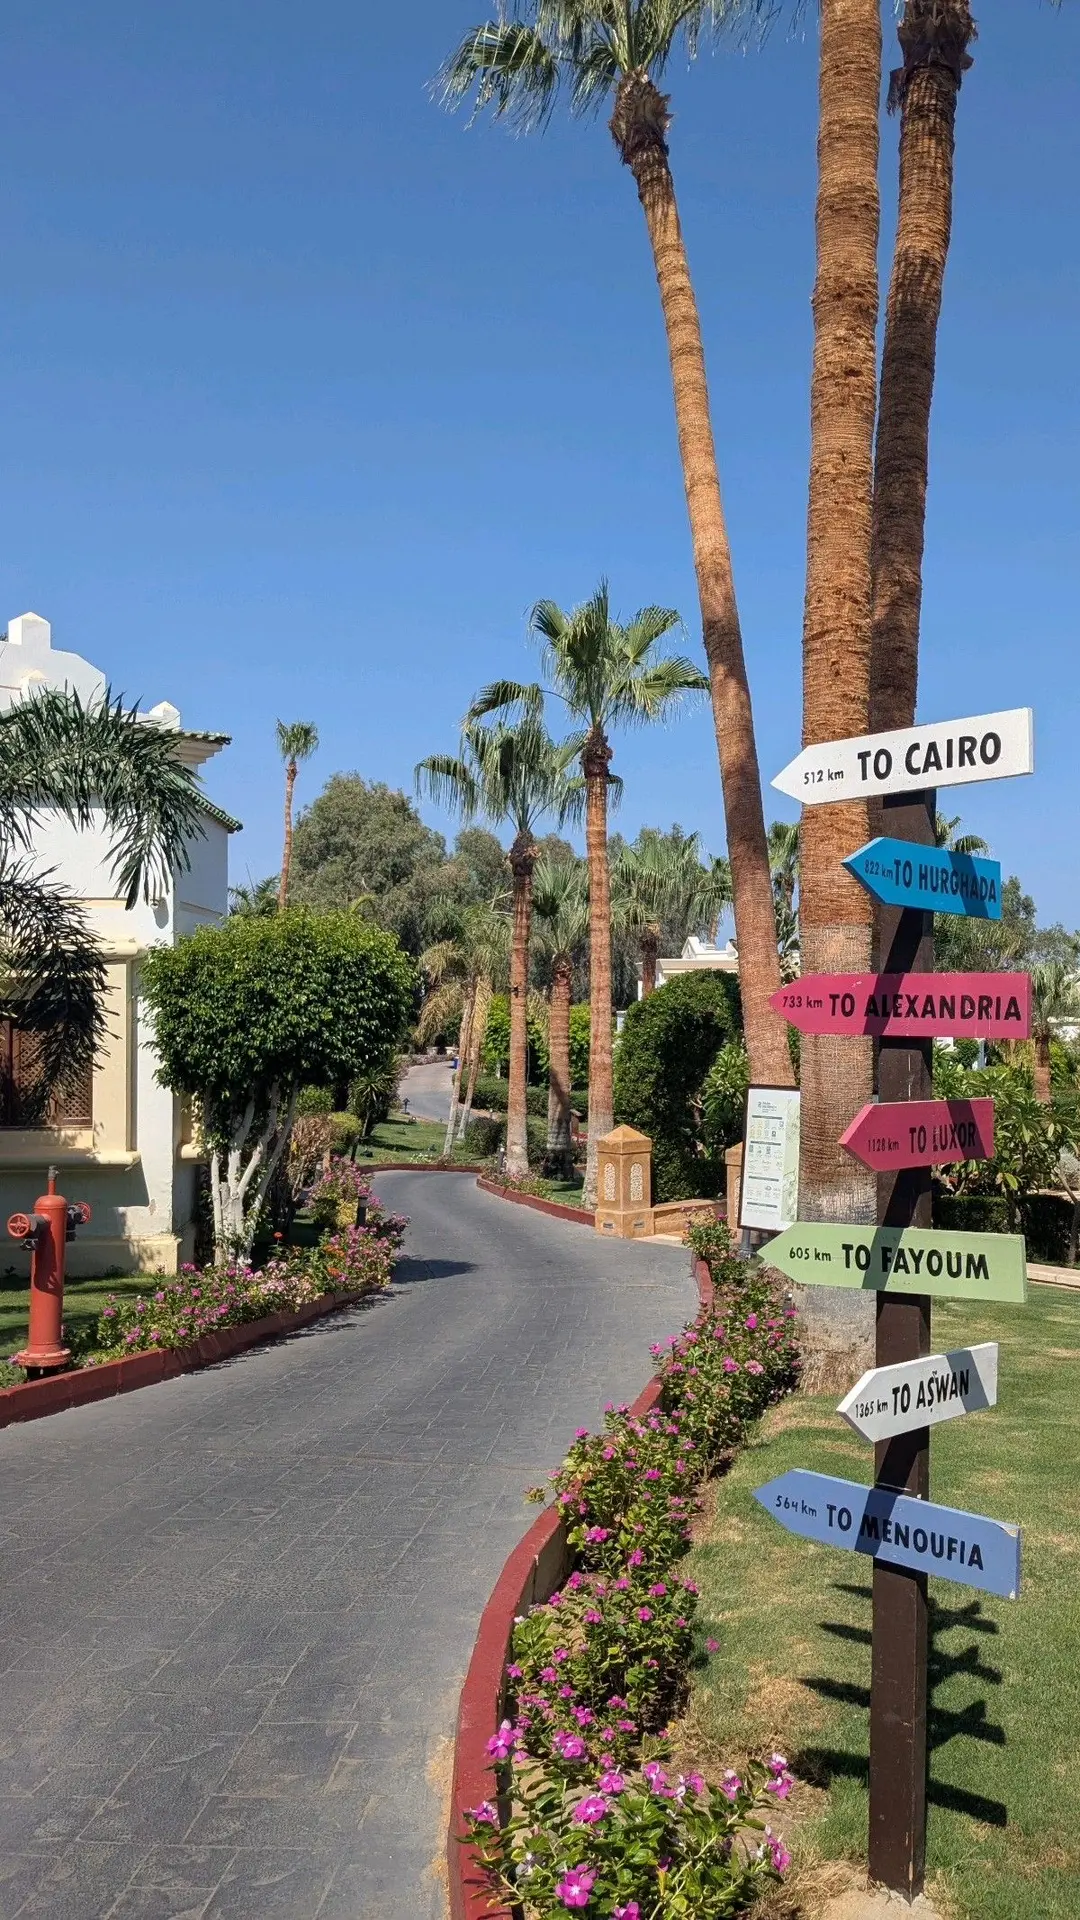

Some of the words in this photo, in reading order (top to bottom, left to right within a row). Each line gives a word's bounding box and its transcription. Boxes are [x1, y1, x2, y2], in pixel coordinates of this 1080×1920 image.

[803, 770, 824, 785] 512
[827, 769, 845, 781] km
[857, 748, 893, 781] TO
[904, 731, 1002, 775] CAIRO
[864, 859, 880, 875] 822
[881, 865, 894, 880] km
[894, 858, 913, 889] TO
[918, 863, 997, 903] HURGHADA
[782, 995, 803, 1009] 733
[806, 995, 823, 1009] km
[828, 993, 856, 1017] TO
[864, 994, 1022, 1021] ALEXANDRIA
[867, 1137, 886, 1152] 1128
[888, 1138, 900, 1151] km
[909, 1125, 927, 1154] TO
[932, 1121, 976, 1152] LUXOR
[789, 1247, 811, 1261] 605
[814, 1248, 832, 1262] km
[841, 1243, 871, 1271] TO
[880, 1246, 990, 1280] FAYOUM
[855, 1400, 874, 1418] 1365
[876, 1399, 889, 1412] km
[891, 1382, 911, 1416] TO
[916, 1369, 970, 1411] ASWAN
[775, 1495, 799, 1513] 564
[800, 1499, 818, 1518] km
[826, 1503, 853, 1532] TO
[859, 1514, 984, 1571] MENOUFIA
